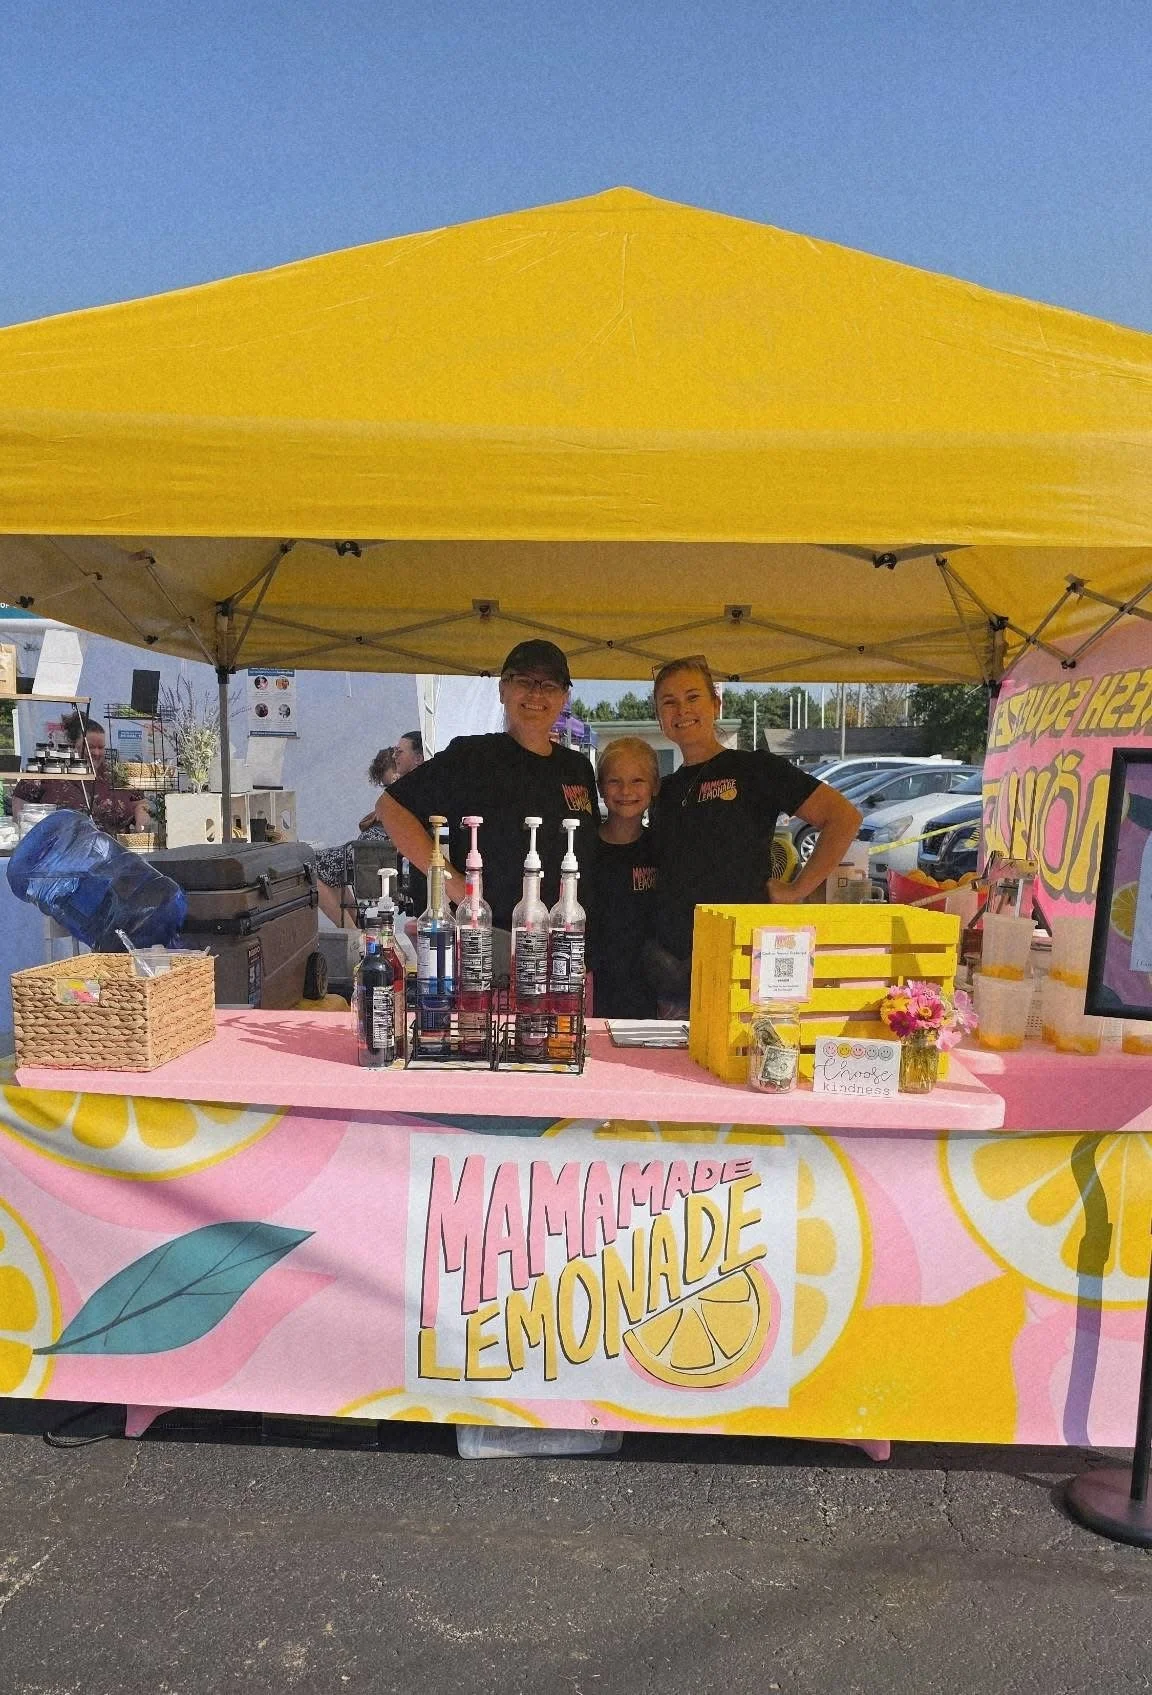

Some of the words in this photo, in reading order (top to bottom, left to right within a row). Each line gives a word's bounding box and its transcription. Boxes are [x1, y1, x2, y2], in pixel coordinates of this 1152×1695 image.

[816, 1057, 893, 1084] Choose
[823, 1082, 890, 1095] kindness
[418, 1173, 768, 1381] LEMONADE
[420, 1154, 754, 1329] MAMAMADE
